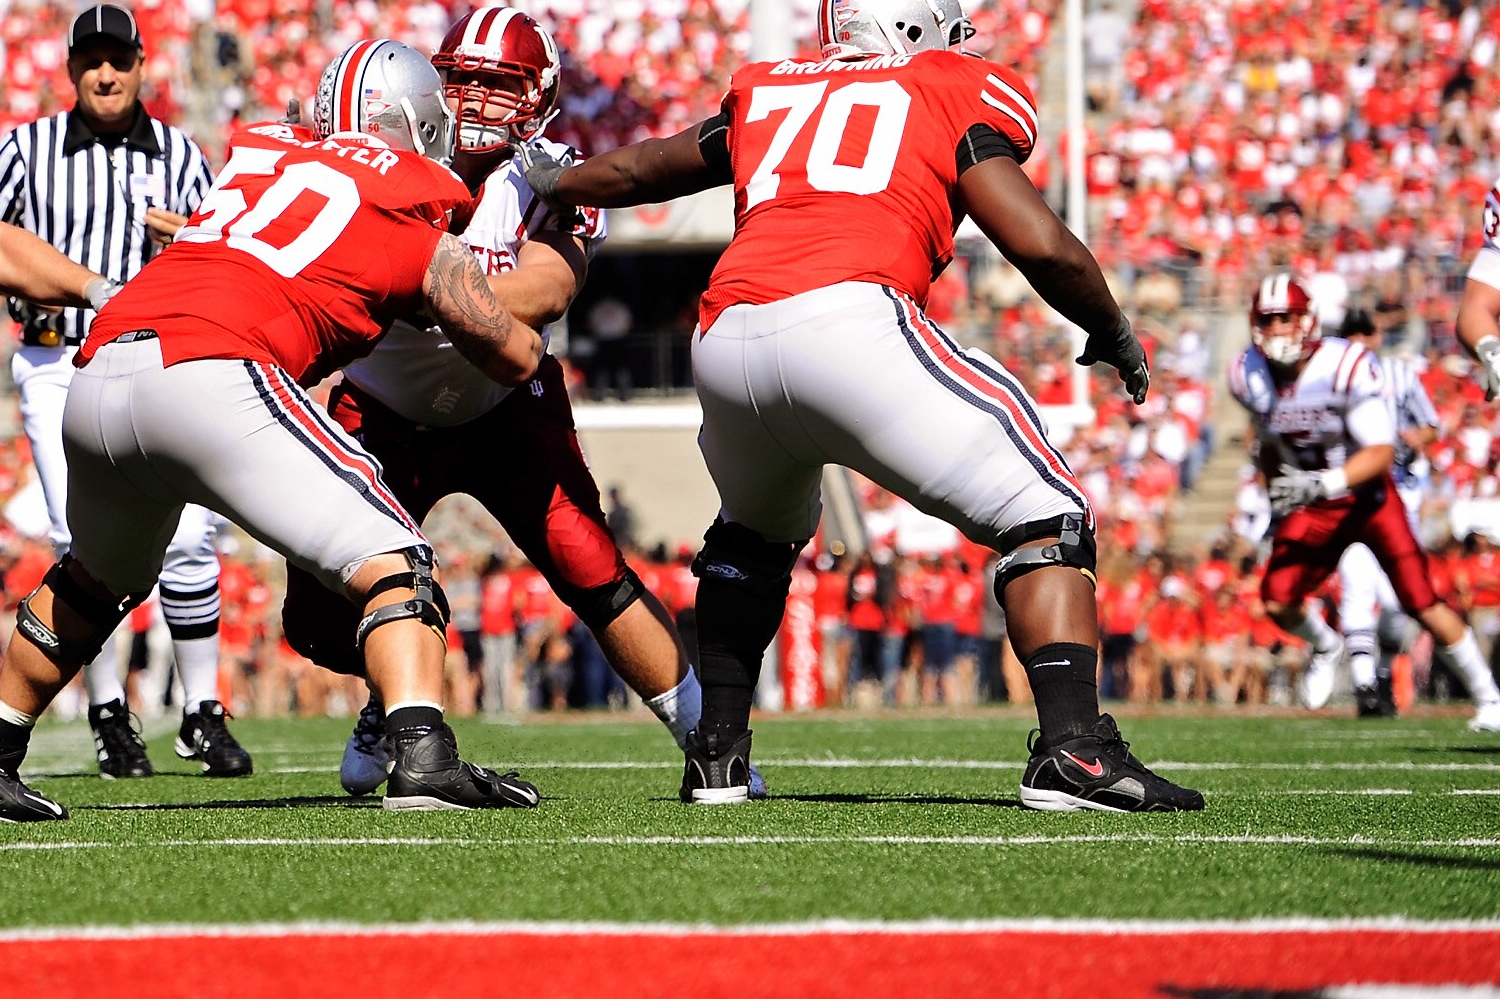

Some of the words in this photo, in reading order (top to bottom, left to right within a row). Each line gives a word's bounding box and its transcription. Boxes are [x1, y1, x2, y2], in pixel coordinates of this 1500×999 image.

[839, 31, 851, 42] 70
[769, 51, 919, 75] BROWNING
[367, 122, 380, 133] 50
[745, 79, 912, 215] 70
[173, 145, 361, 279] 50
[22, 619, 59, 647] DONJOY
